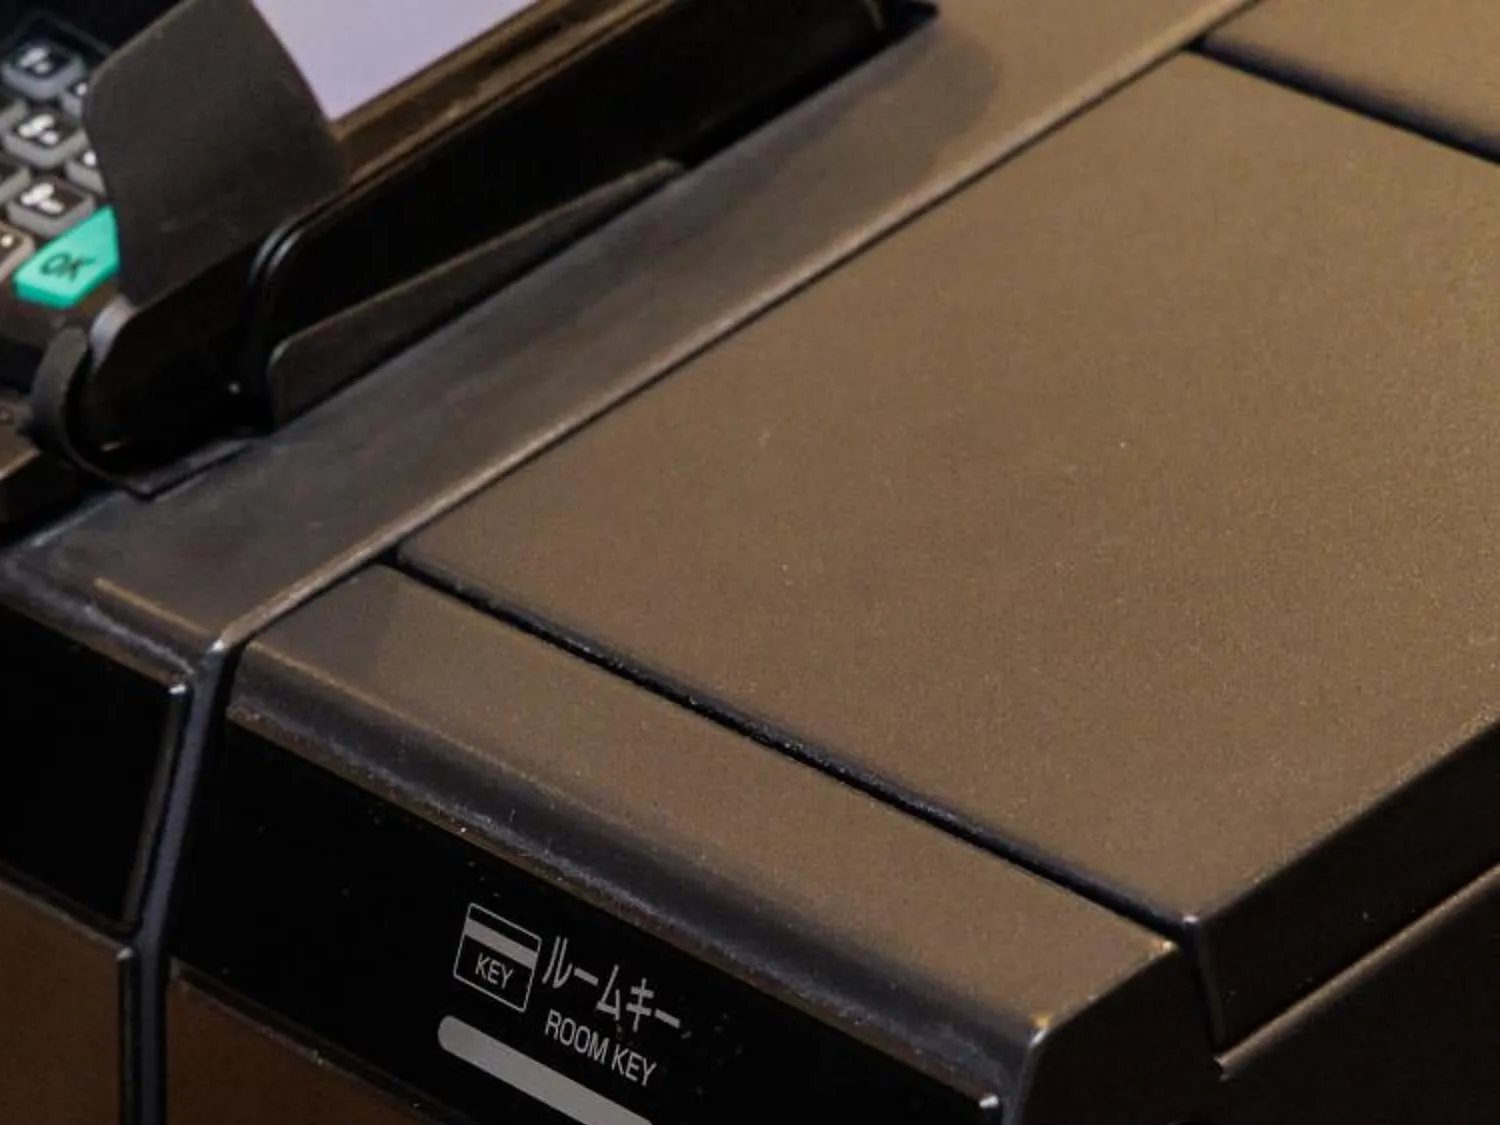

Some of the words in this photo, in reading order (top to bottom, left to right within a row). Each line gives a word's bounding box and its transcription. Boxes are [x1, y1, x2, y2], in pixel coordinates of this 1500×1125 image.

[40, 252, 96, 282] OK
[475, 952, 513, 989] KEY
[541, 935, 681, 1032] ルームキー
[544, 1009, 610, 1065] ROOM
[611, 1044, 658, 1087] KEY
